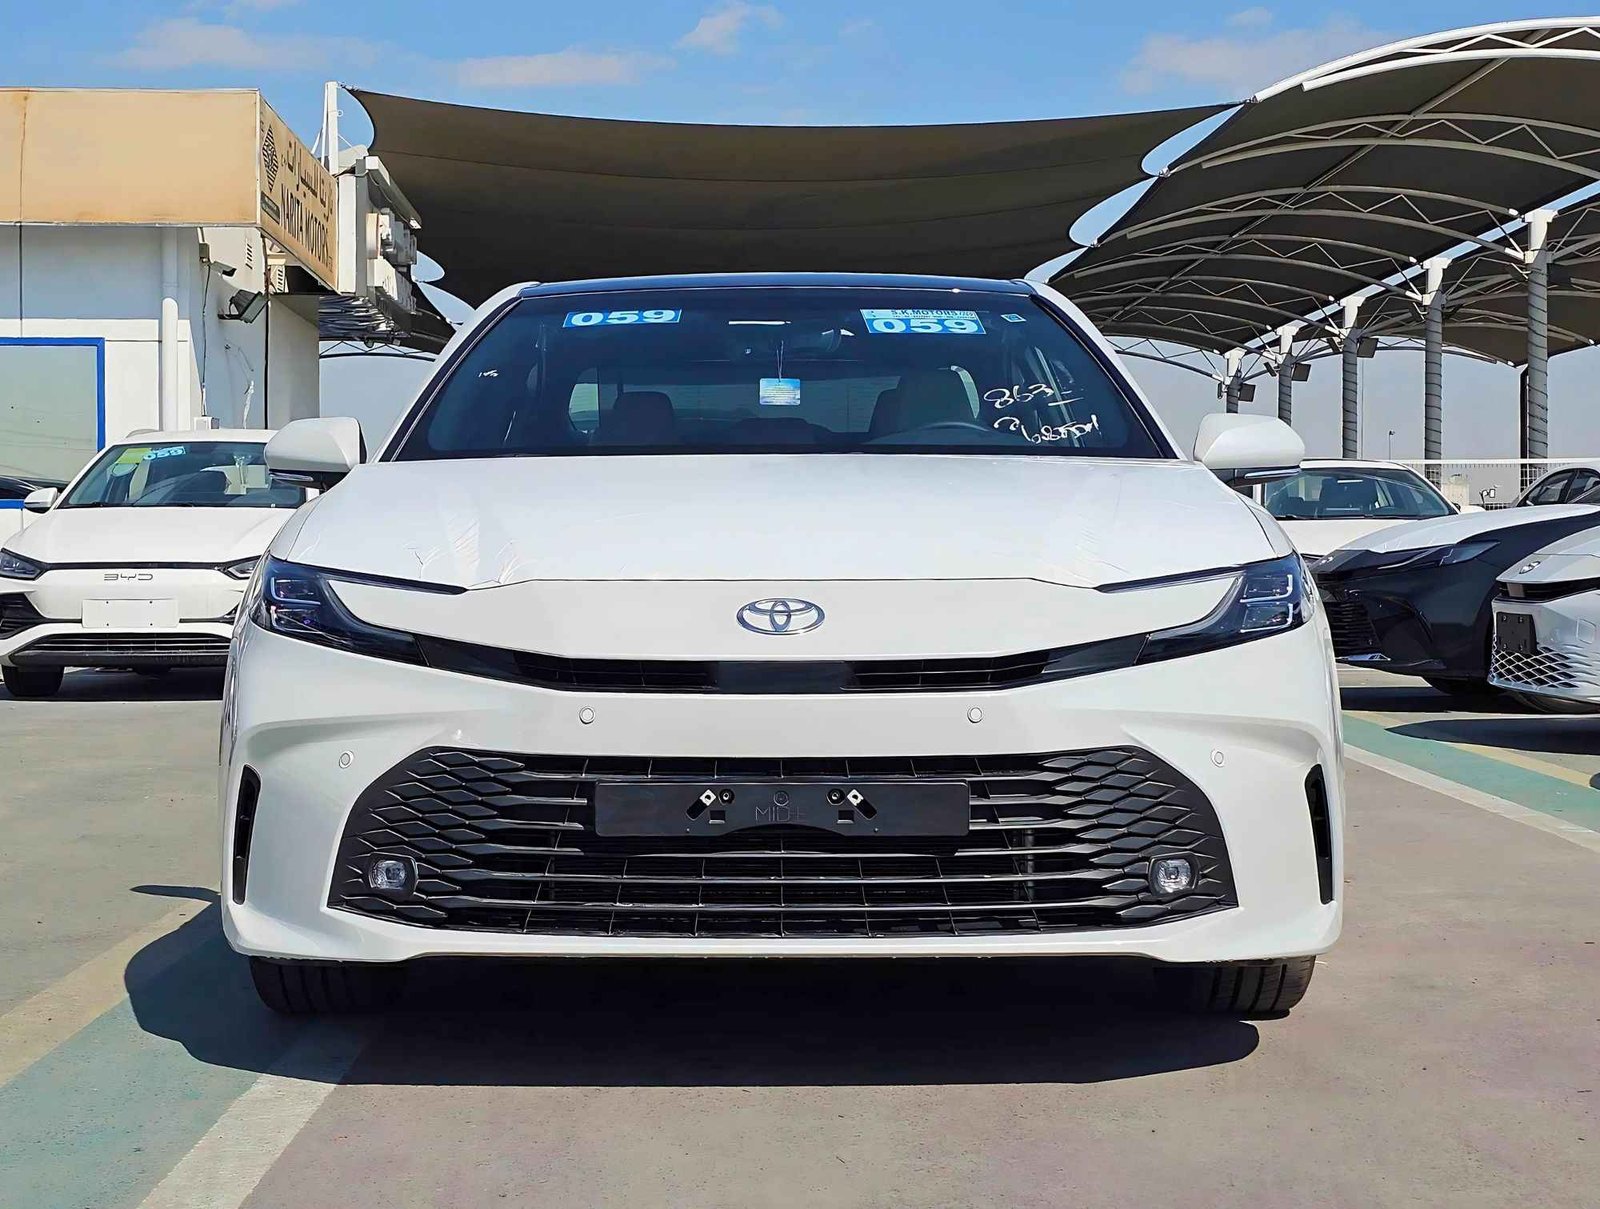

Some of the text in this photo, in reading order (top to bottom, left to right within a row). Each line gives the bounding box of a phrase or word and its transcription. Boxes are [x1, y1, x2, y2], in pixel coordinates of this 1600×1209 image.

[281, 183, 304, 246] NARITA
[304, 207, 329, 267] MOTORS
[570, 309, 676, 326] 059
[872, 319, 979, 333] 059
[103, 573, 154, 582] BYD
